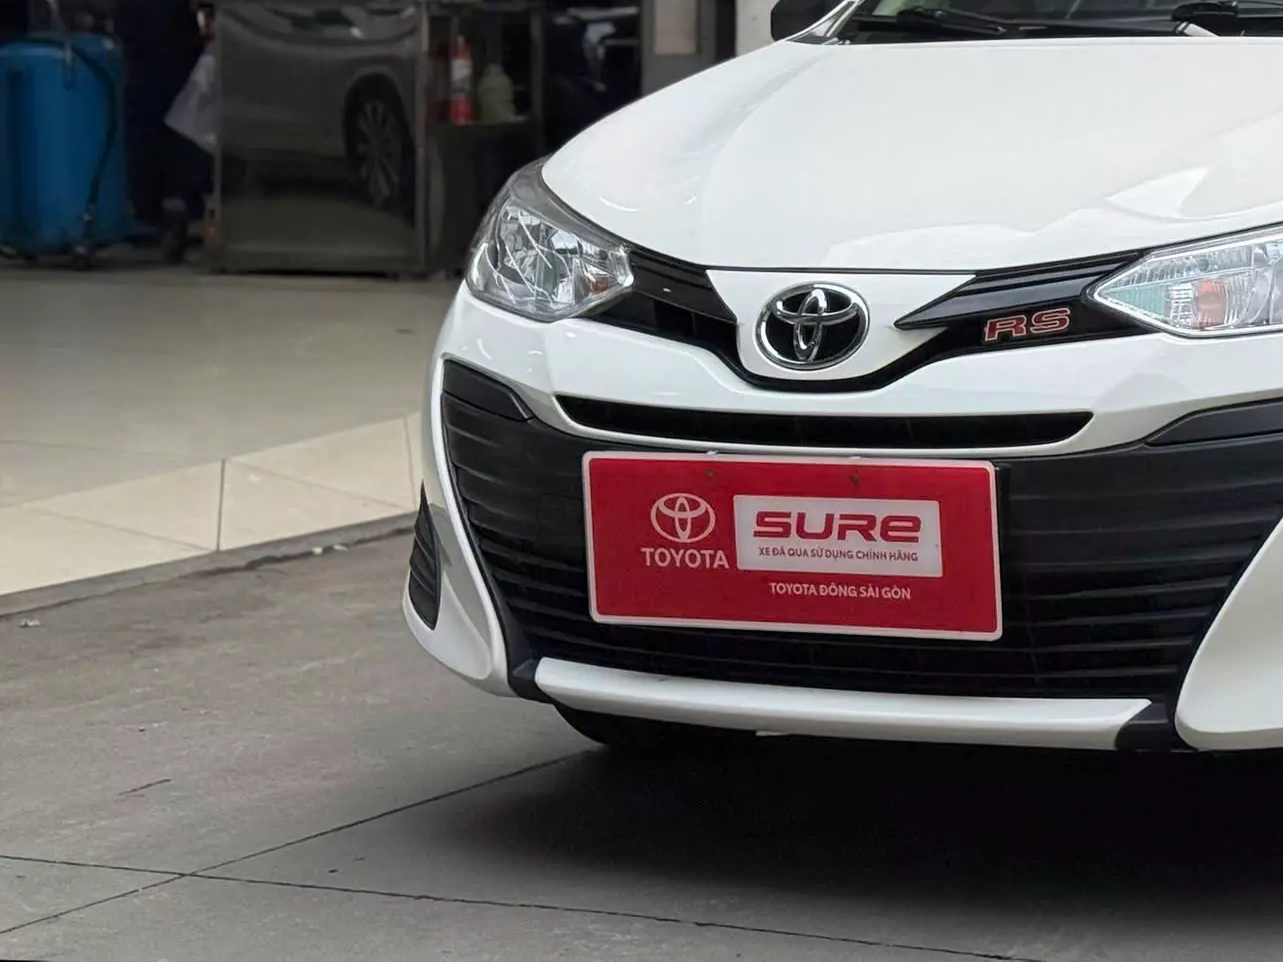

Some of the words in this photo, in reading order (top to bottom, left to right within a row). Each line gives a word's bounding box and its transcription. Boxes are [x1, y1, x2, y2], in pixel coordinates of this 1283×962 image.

[984, 307, 1071, 342] RS
[640, 547, 730, 569] TOYOTA
[758, 546, 771, 556] XE
[787, 548, 809, 557] QUA
[825, 549, 854, 562] DỤNG
[855, 548, 887, 561] CHÍNH
[769, 581, 818, 596] TOYOTA
[819, 582, 858, 597] ĐÔNG
[859, 583, 880, 598] SÀI
[881, 585, 911, 600] GÒN
